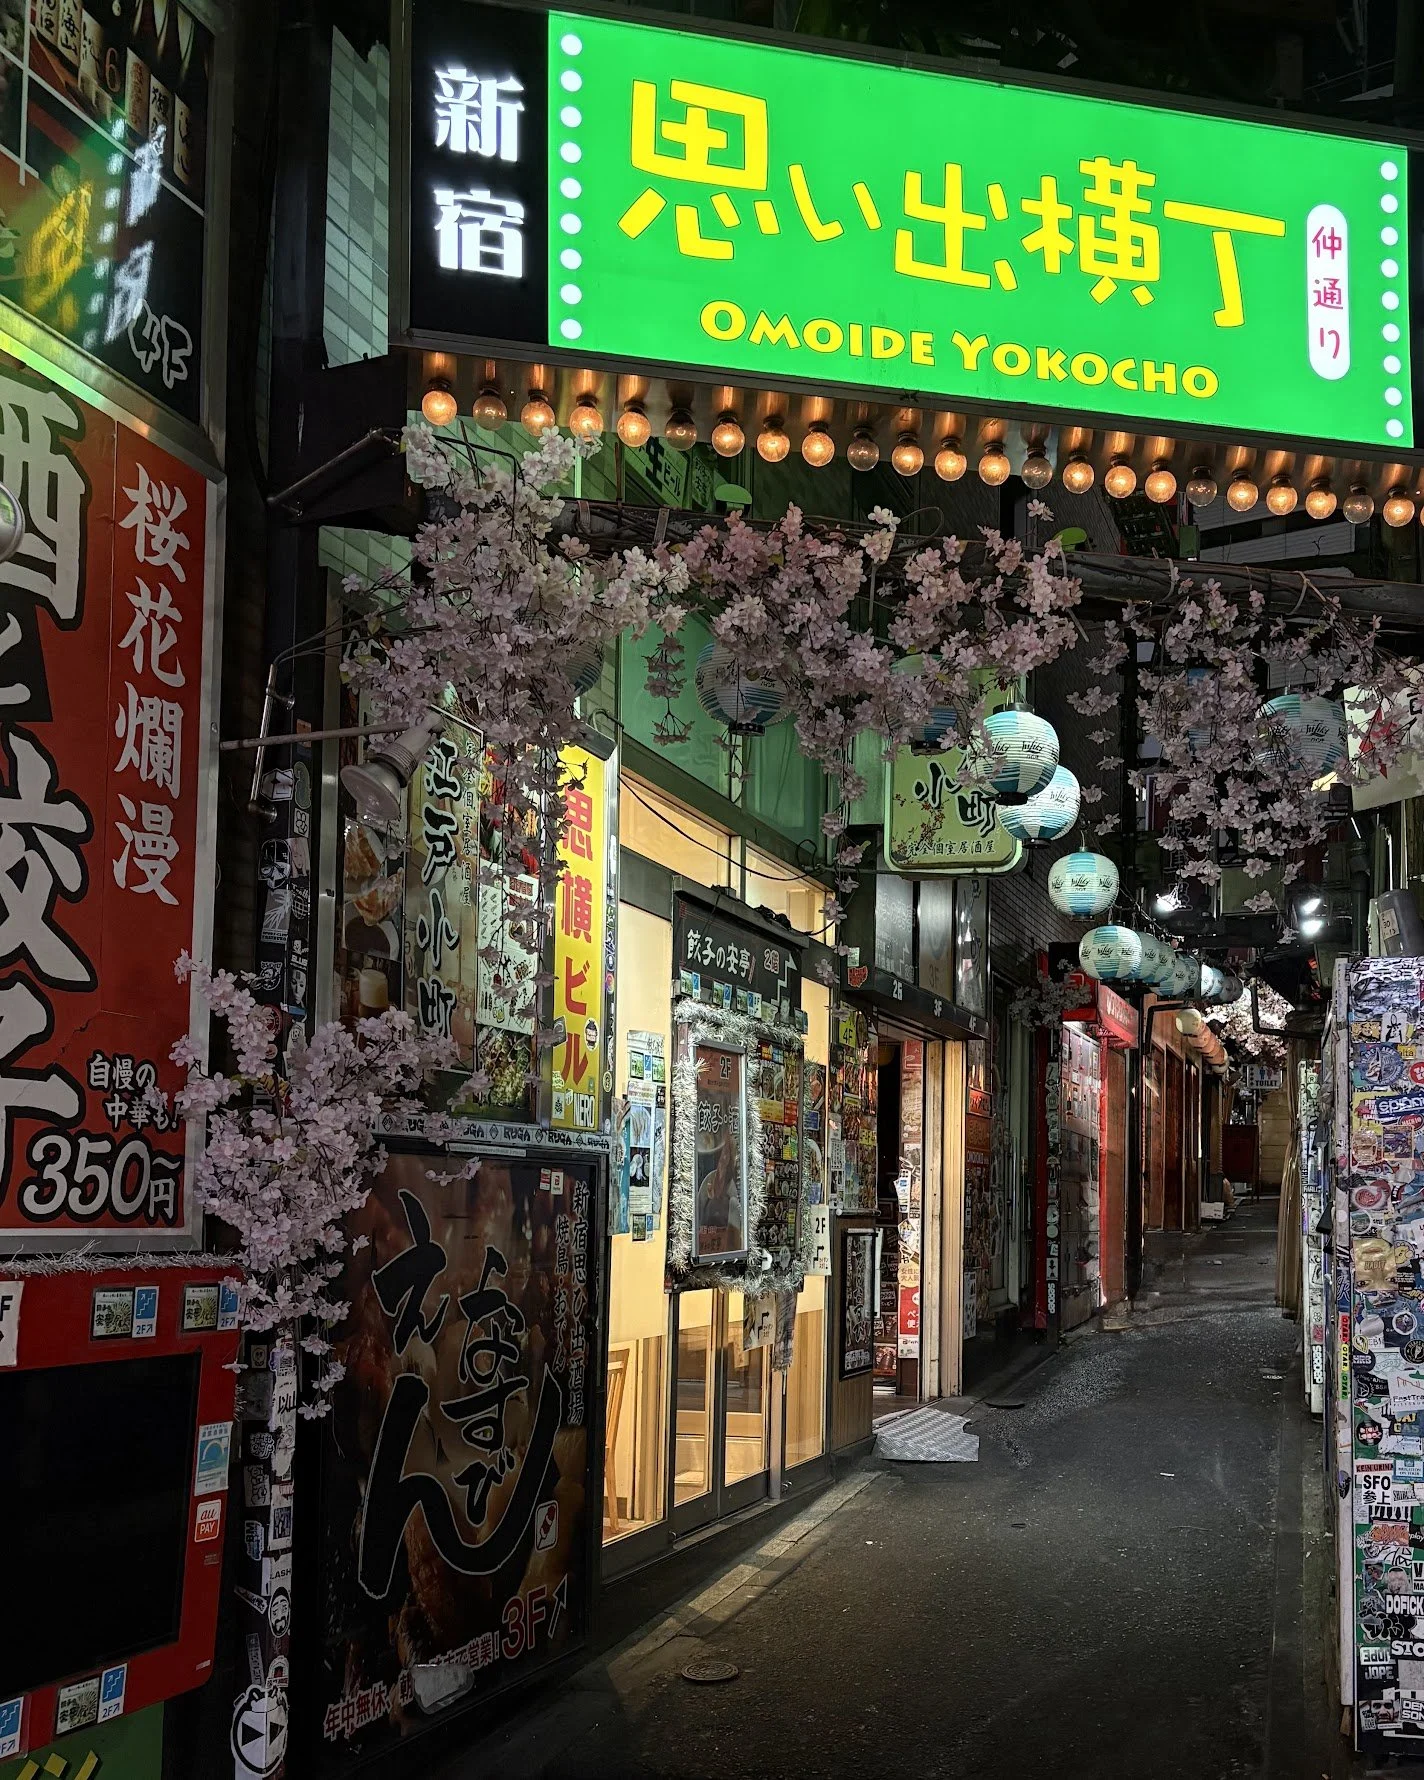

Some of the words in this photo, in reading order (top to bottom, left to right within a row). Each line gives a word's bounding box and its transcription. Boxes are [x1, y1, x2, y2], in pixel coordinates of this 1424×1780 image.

[433, 66, 525, 280] 新宿
[617, 78, 1287, 329] 思い出横丁
[1311, 225, 1345, 361] 仲通り
[700, 300, 935, 366] OMOIDE
[950, 330, 1220, 399] YOKOCHO
[112, 460, 190, 907] 桜花爛漫
[906, 840, 997, 858] 完全個室居酒屋
[560, 789, 594, 1087] 思横ビル
[686, 928, 751, 979] 餃子の安亭
[892, 979, 903, 1001] 2F
[90, 1053, 157, 1088] 自慢の
[719, 1054, 732, 1080] 2F
[815, 1217, 826, 1235] 2F
[567, 1179, 590, 1427] 新宿思ひ出酒場
[136, 1324, 147, 1335] 2F
[1362, 1490, 1391, 1505] 参上
[1363, 1474, 1391, 1491] SFO
[200, 1521, 215, 1534] PAY
[201, 1508, 216, 1520] au
[502, 1585, 548, 1660] 3F
[102, 1704, 113, 1718] 2F
